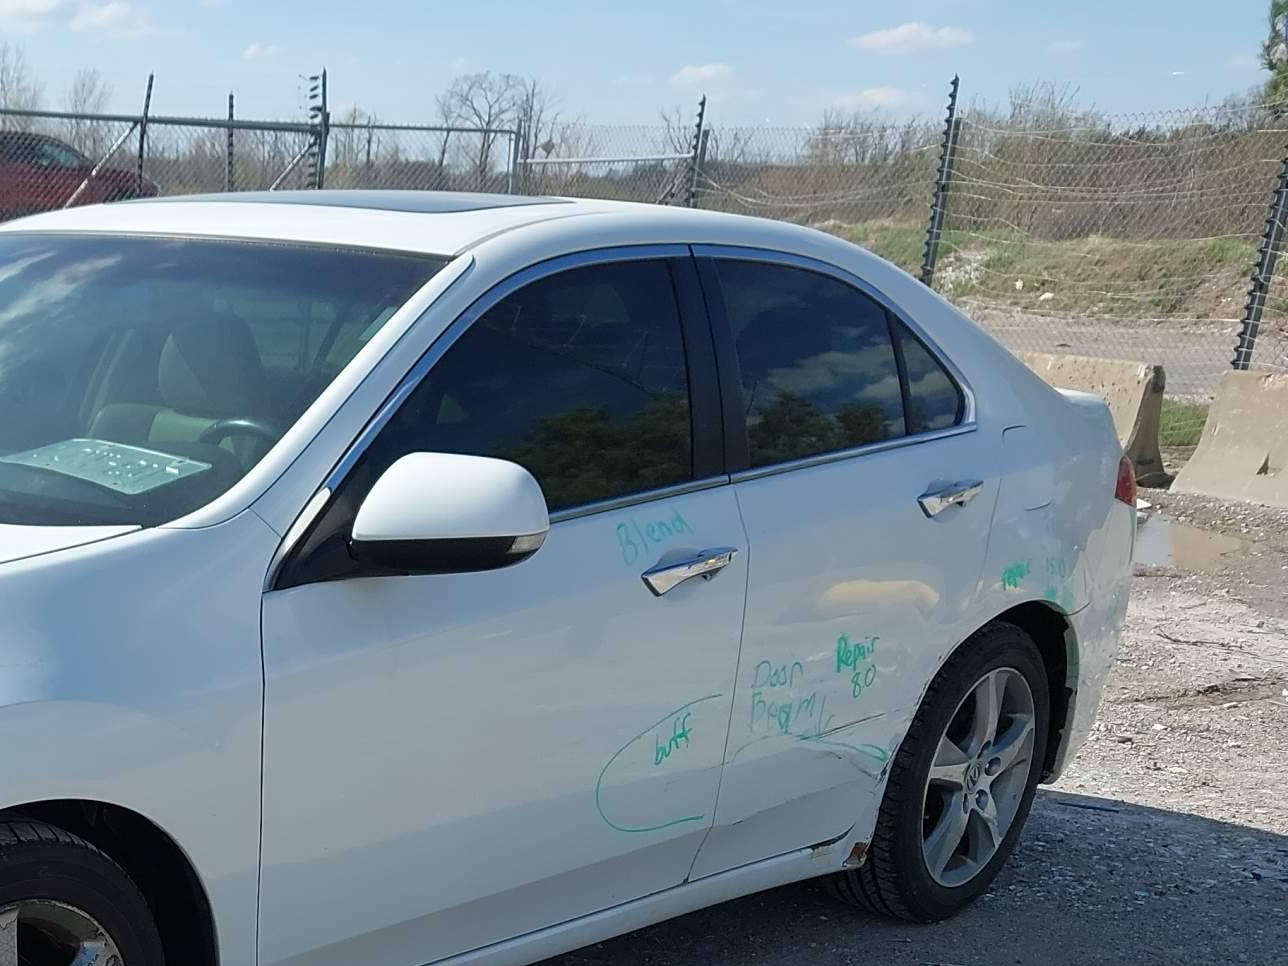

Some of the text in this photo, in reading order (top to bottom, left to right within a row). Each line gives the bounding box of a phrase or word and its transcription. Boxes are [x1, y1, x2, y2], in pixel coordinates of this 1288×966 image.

[616, 511, 695, 567] Blend
[837, 634, 880, 673] Repair
[654, 712, 692, 766] buff
